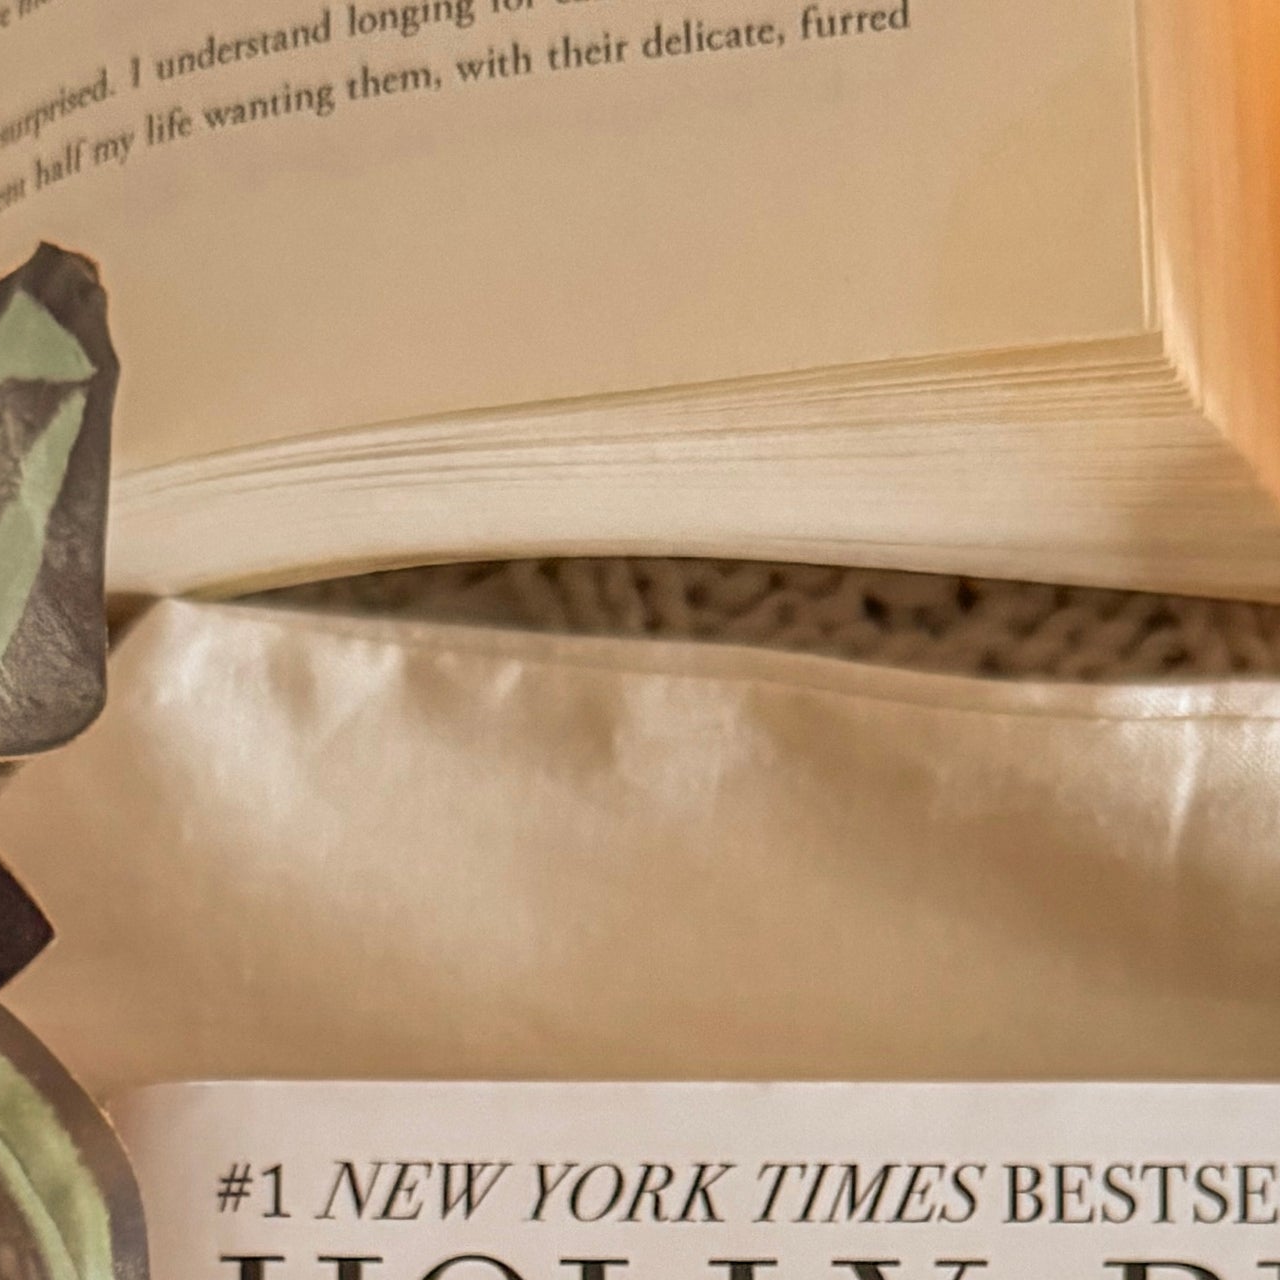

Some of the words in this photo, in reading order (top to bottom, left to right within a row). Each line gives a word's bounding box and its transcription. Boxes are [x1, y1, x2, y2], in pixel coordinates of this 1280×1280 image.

[128, 56, 142, 90] I
[155, 9, 332, 82] understand
[346, 0, 475, 37] longing
[33, 136, 89, 190] half
[93, 132, 136, 166] my
[145, 106, 192, 148] life
[204, 81, 336, 130] wanting
[347, 63, 442, 102] them,
[456, 42, 532, 82] with
[548, 31, 629, 72] their
[642, 19, 786, 59] delicate,
[800, 0, 912, 40] furred
[216, 1161, 293, 1219] #1
[314, 1160, 509, 1222] NEW
[524, 1161, 738, 1224] YORK
[750, 1161, 987, 1225] TIMES
